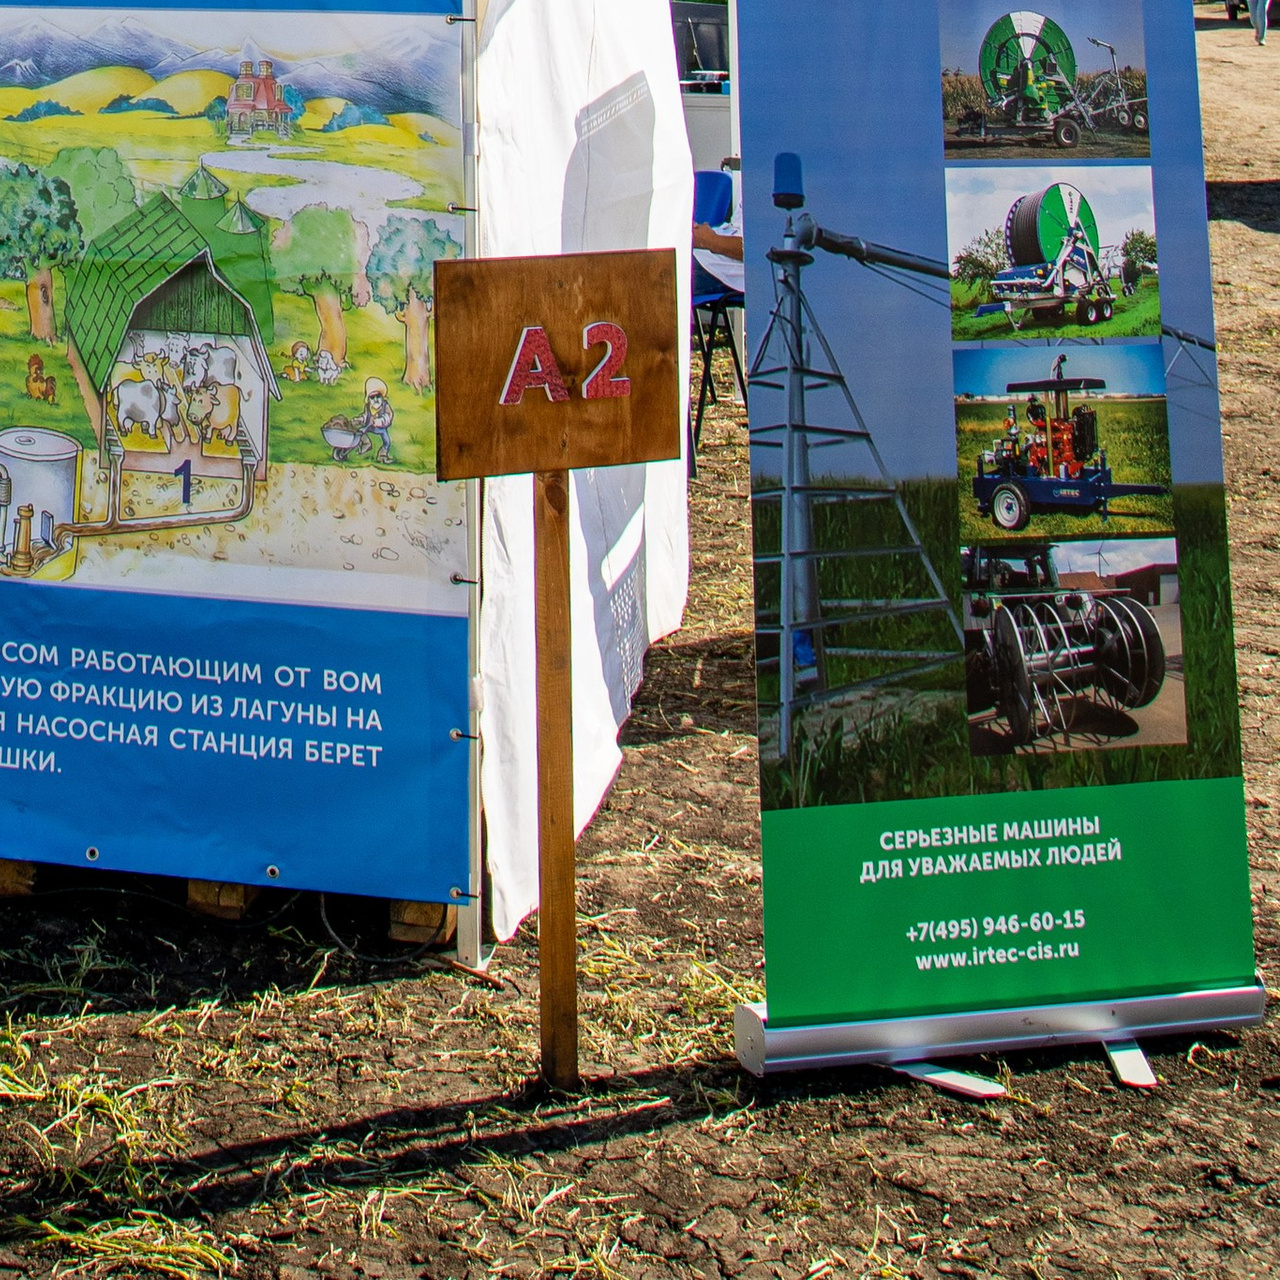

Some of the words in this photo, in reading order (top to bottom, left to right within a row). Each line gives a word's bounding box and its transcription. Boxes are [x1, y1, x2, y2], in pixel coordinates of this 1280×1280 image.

[173, 458, 193, 504] 1
[71, 648, 262, 685] РАБОТАЮЩИМ
[274, 666, 311, 688] ОТ
[323, 669, 382, 695] ВОМ
[49, 681, 183, 713] ФРАКЦИЮ
[191, 694, 223, 717] ИЗ
[230, 698, 337, 727] ЛАГУНЫ
[346, 707, 383, 731] НА
[17, 713, 158, 747] НАСОСНАЯ
[169, 728, 293, 760] СТАНЦИЯ
[305, 740, 383, 767] БЕРЕТ
[879, 823, 999, 851] СЕРЬЕЗНЫЕ
[1003, 816, 1100, 841] МАШИНЫ
[859, 859, 904, 884] ДЛЯ
[908, 848, 1042, 877] УВАЖАЕМЫХ
[1046, 837, 1122, 866] ЛЮДЕЙ
[906, 917, 978, 943] +7(495)
[982, 909, 1086, 936] 946-60-15
[915, 941, 1080, 971] www.irtec-cis.ru
